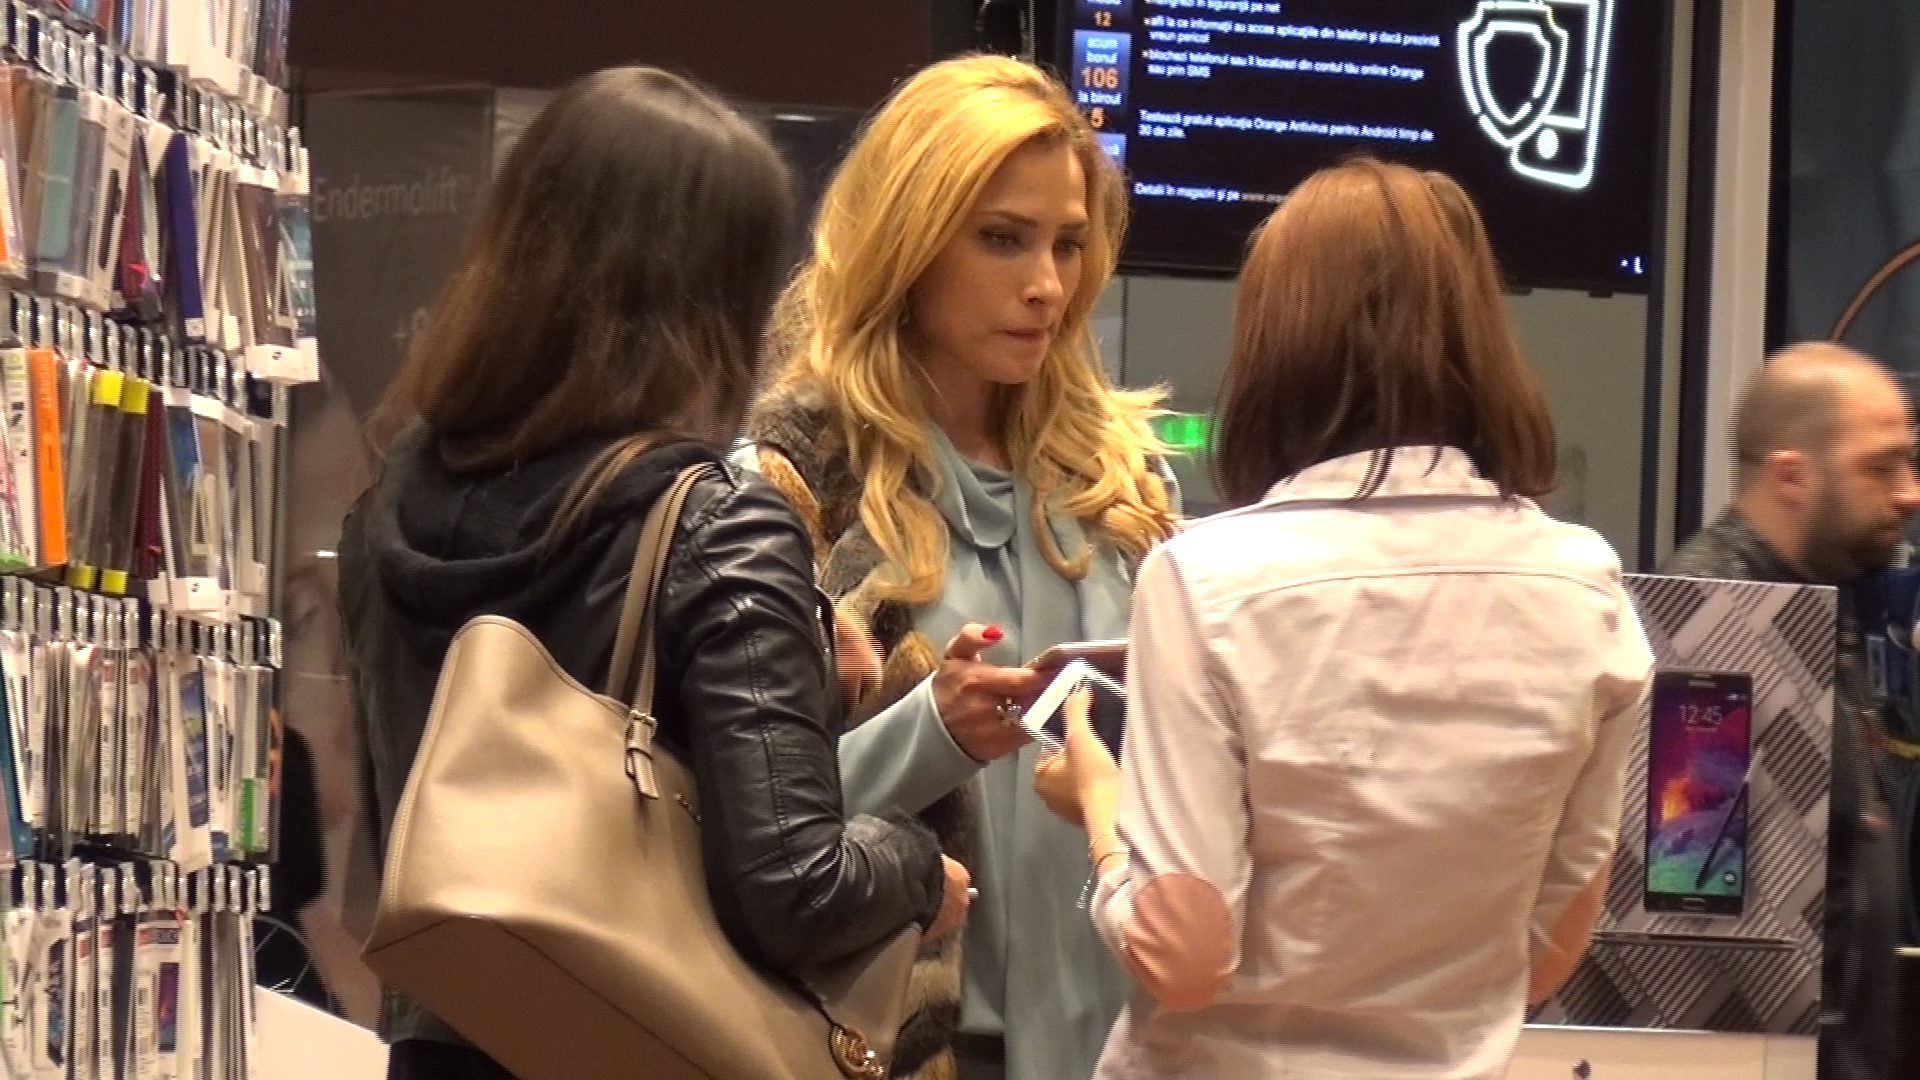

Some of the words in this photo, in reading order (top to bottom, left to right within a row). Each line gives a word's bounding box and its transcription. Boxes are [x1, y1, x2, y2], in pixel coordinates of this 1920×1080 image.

[1264, 3, 1280, 12] net
[1094, 11, 1112, 27] 12
[1177, 32, 1210, 44] pericol
[1247, 23, 1275, 34] acces
[1320, 27, 1335, 39] din
[1336, 28, 1367, 42] telefon
[1085, 50, 1118, 64] bonul
[1186, 65, 1211, 78] SMS
[1188, 51, 1229, 65] telefonul
[1229, 56, 1247, 66] sau
[1298, 59, 1313, 71] din
[1313, 61, 1343, 73] contul
[1360, 64, 1388, 77] online
[1389, 65, 1425, 81] Orange
[1081, 66, 1119, 88] 106
[1077, 91, 1089, 103] la
[1090, 91, 1122, 105] biroul
[1138, 124, 1152, 136] 30
[1152, 126, 1166, 137] de
[1182, 113, 1212, 126] gratuit
[1253, 117, 1288, 133] Orange
[1289, 120, 1328, 134] Antivirus
[1328, 124, 1359, 136] pentru
[1360, 125, 1398, 138] Android
[1420, 128, 1434, 141] de
[1134, 182, 1165, 196] Detalii
[1176, 187, 1216, 200] magazin
[1226, 190, 1240, 201] pe
[1678, 703, 1722, 725] 12:45
